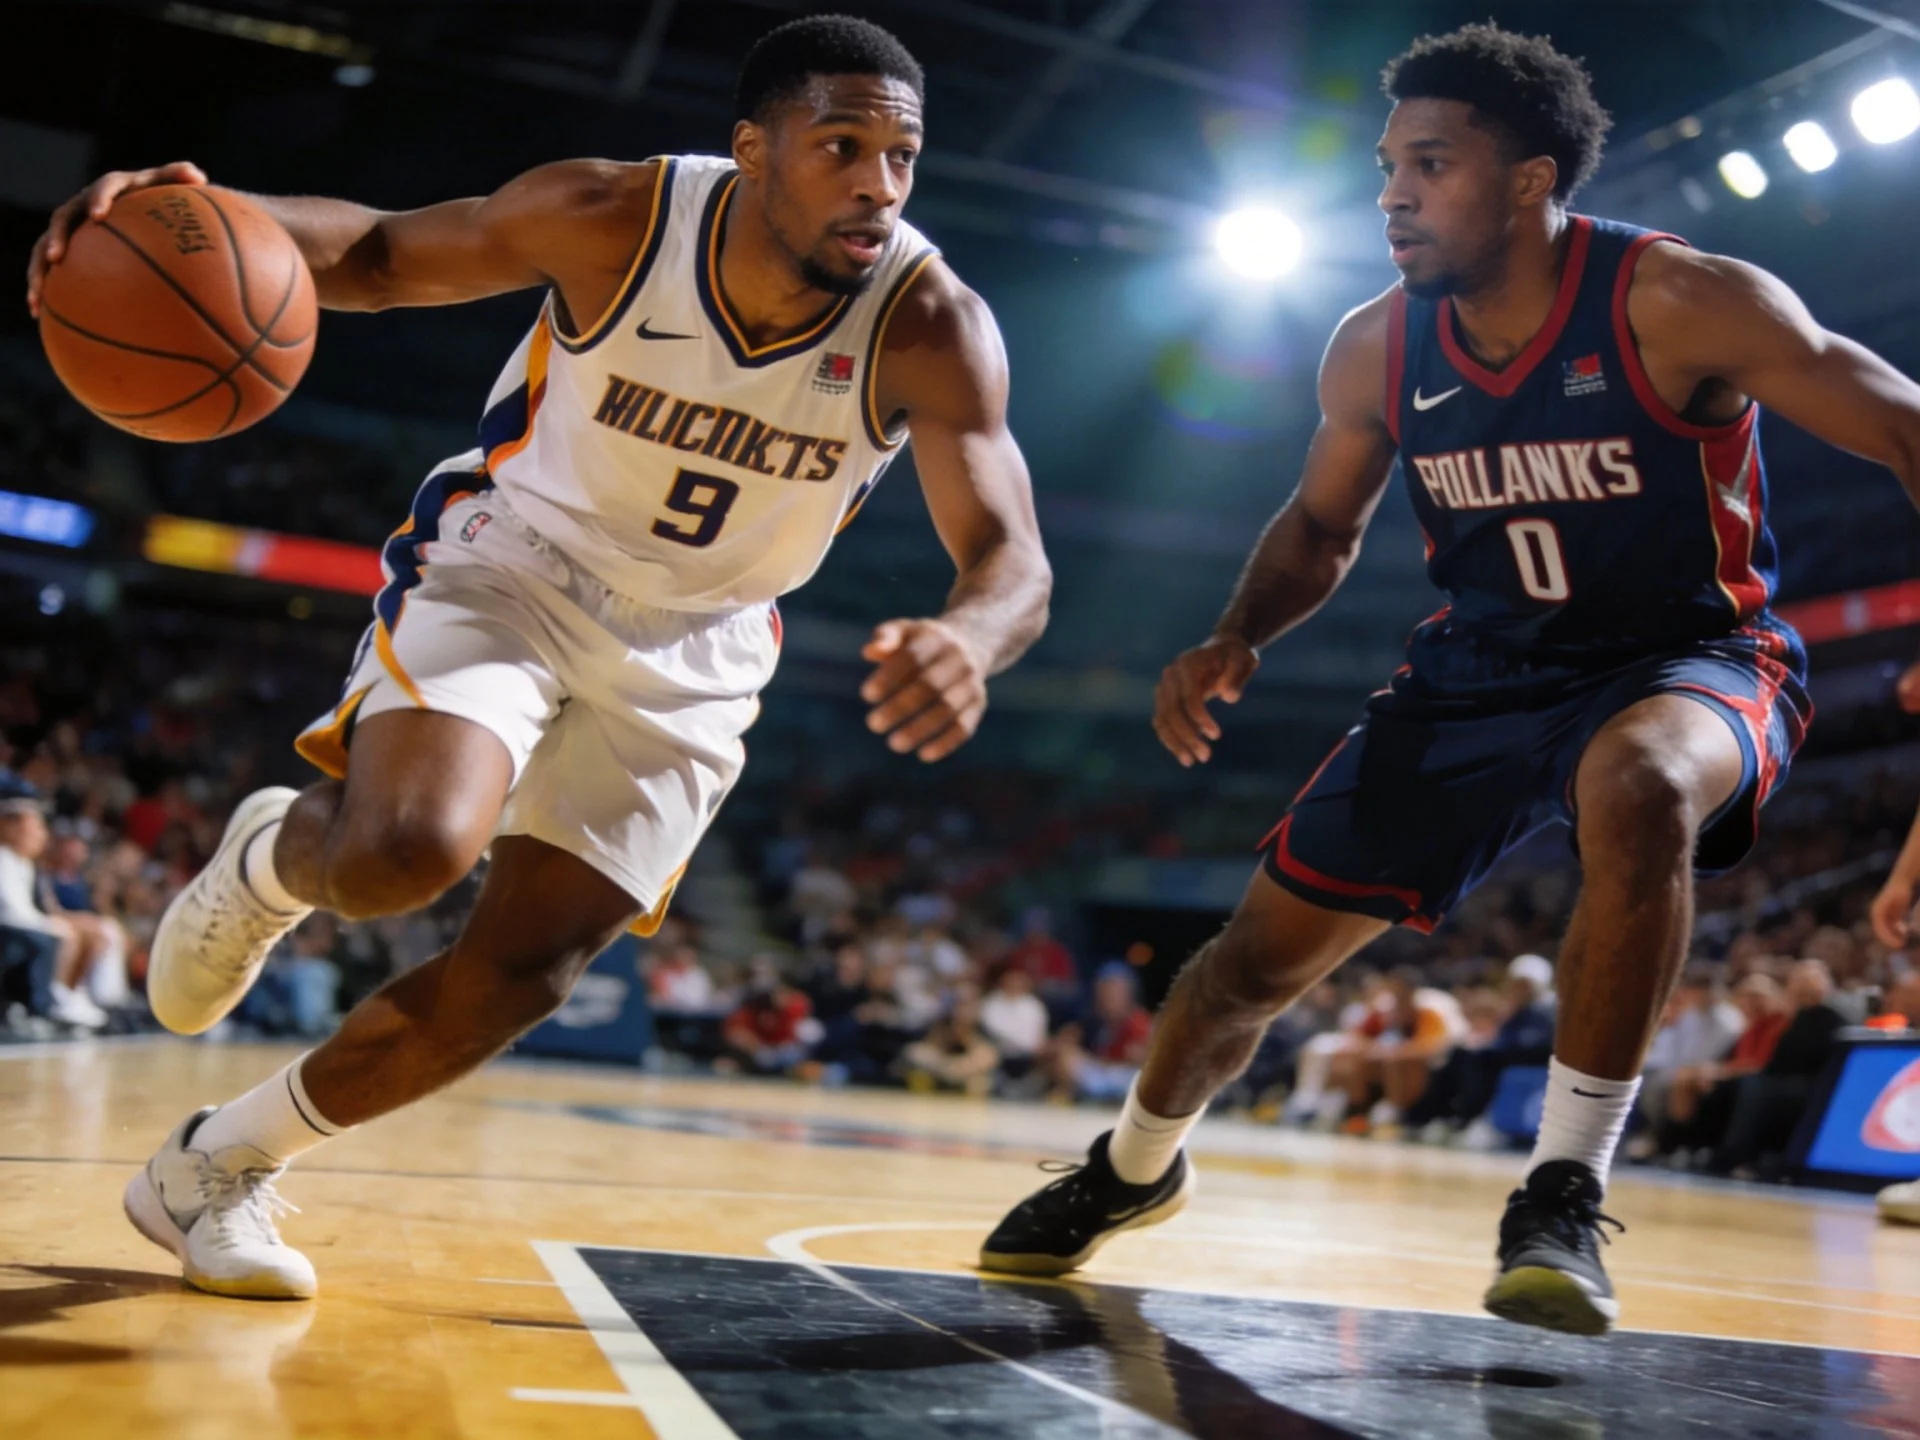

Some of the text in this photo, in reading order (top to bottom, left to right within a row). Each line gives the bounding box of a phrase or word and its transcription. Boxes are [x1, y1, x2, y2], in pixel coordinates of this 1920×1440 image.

[651, 467, 740, 547] 9
[1412, 436, 1642, 509] POLLANKS
[1506, 518, 1571, 602] 0
